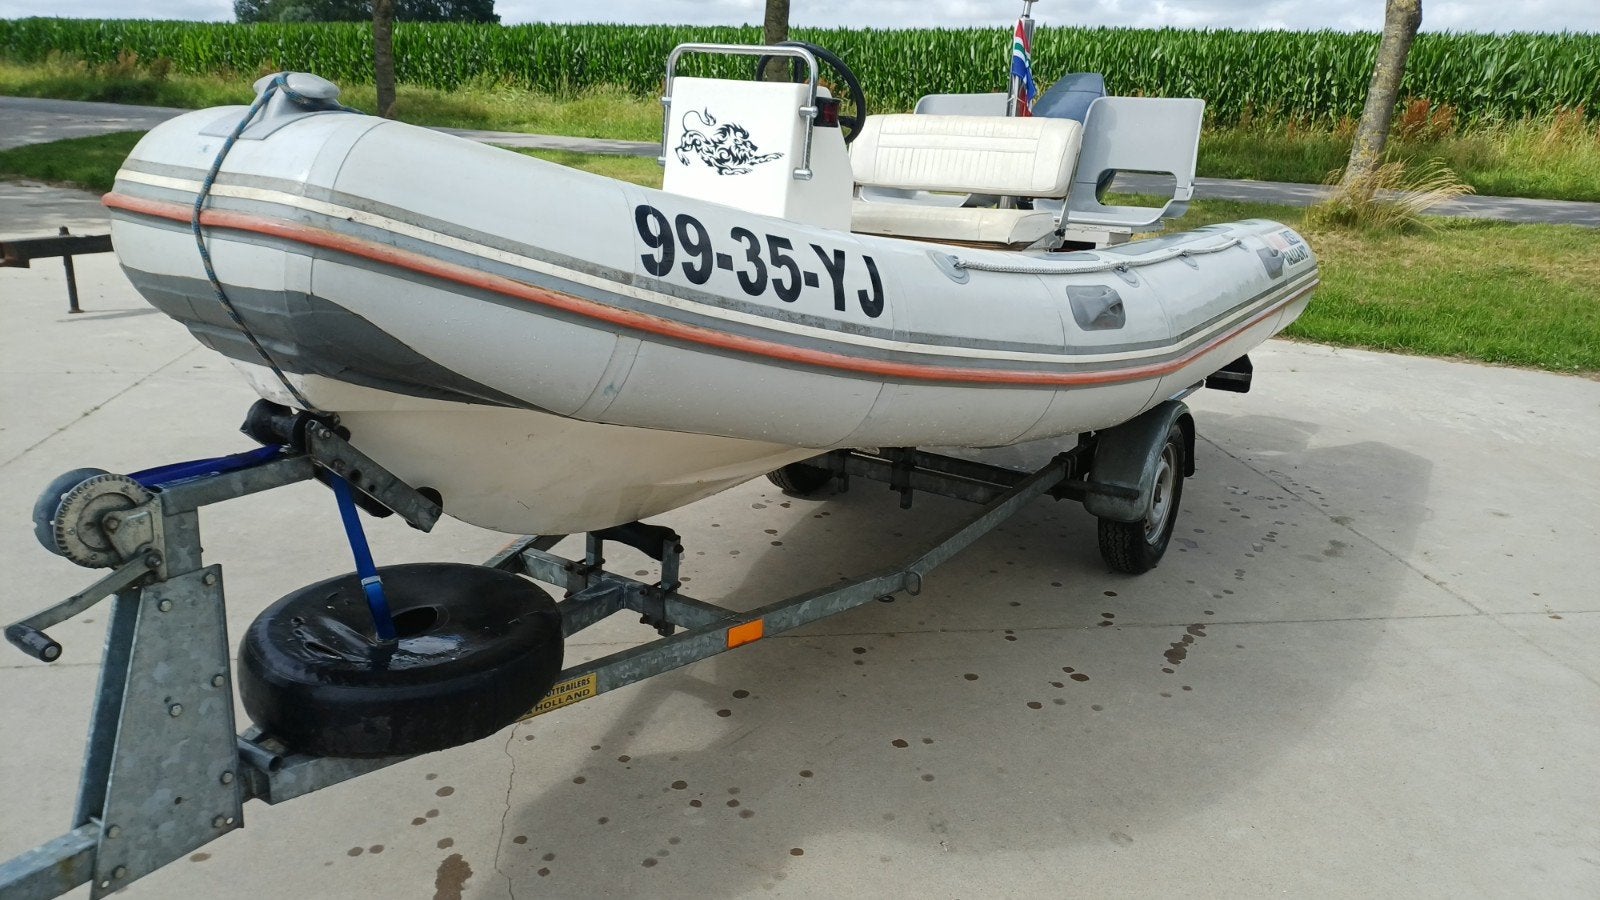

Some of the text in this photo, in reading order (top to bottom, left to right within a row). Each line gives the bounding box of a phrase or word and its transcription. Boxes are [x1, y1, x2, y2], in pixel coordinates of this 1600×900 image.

[634, 204, 885, 318] 99-35-YJ
[545, 677, 591, 697] OTTRAILERS
[535, 688, 590, 712] HOLLAND
